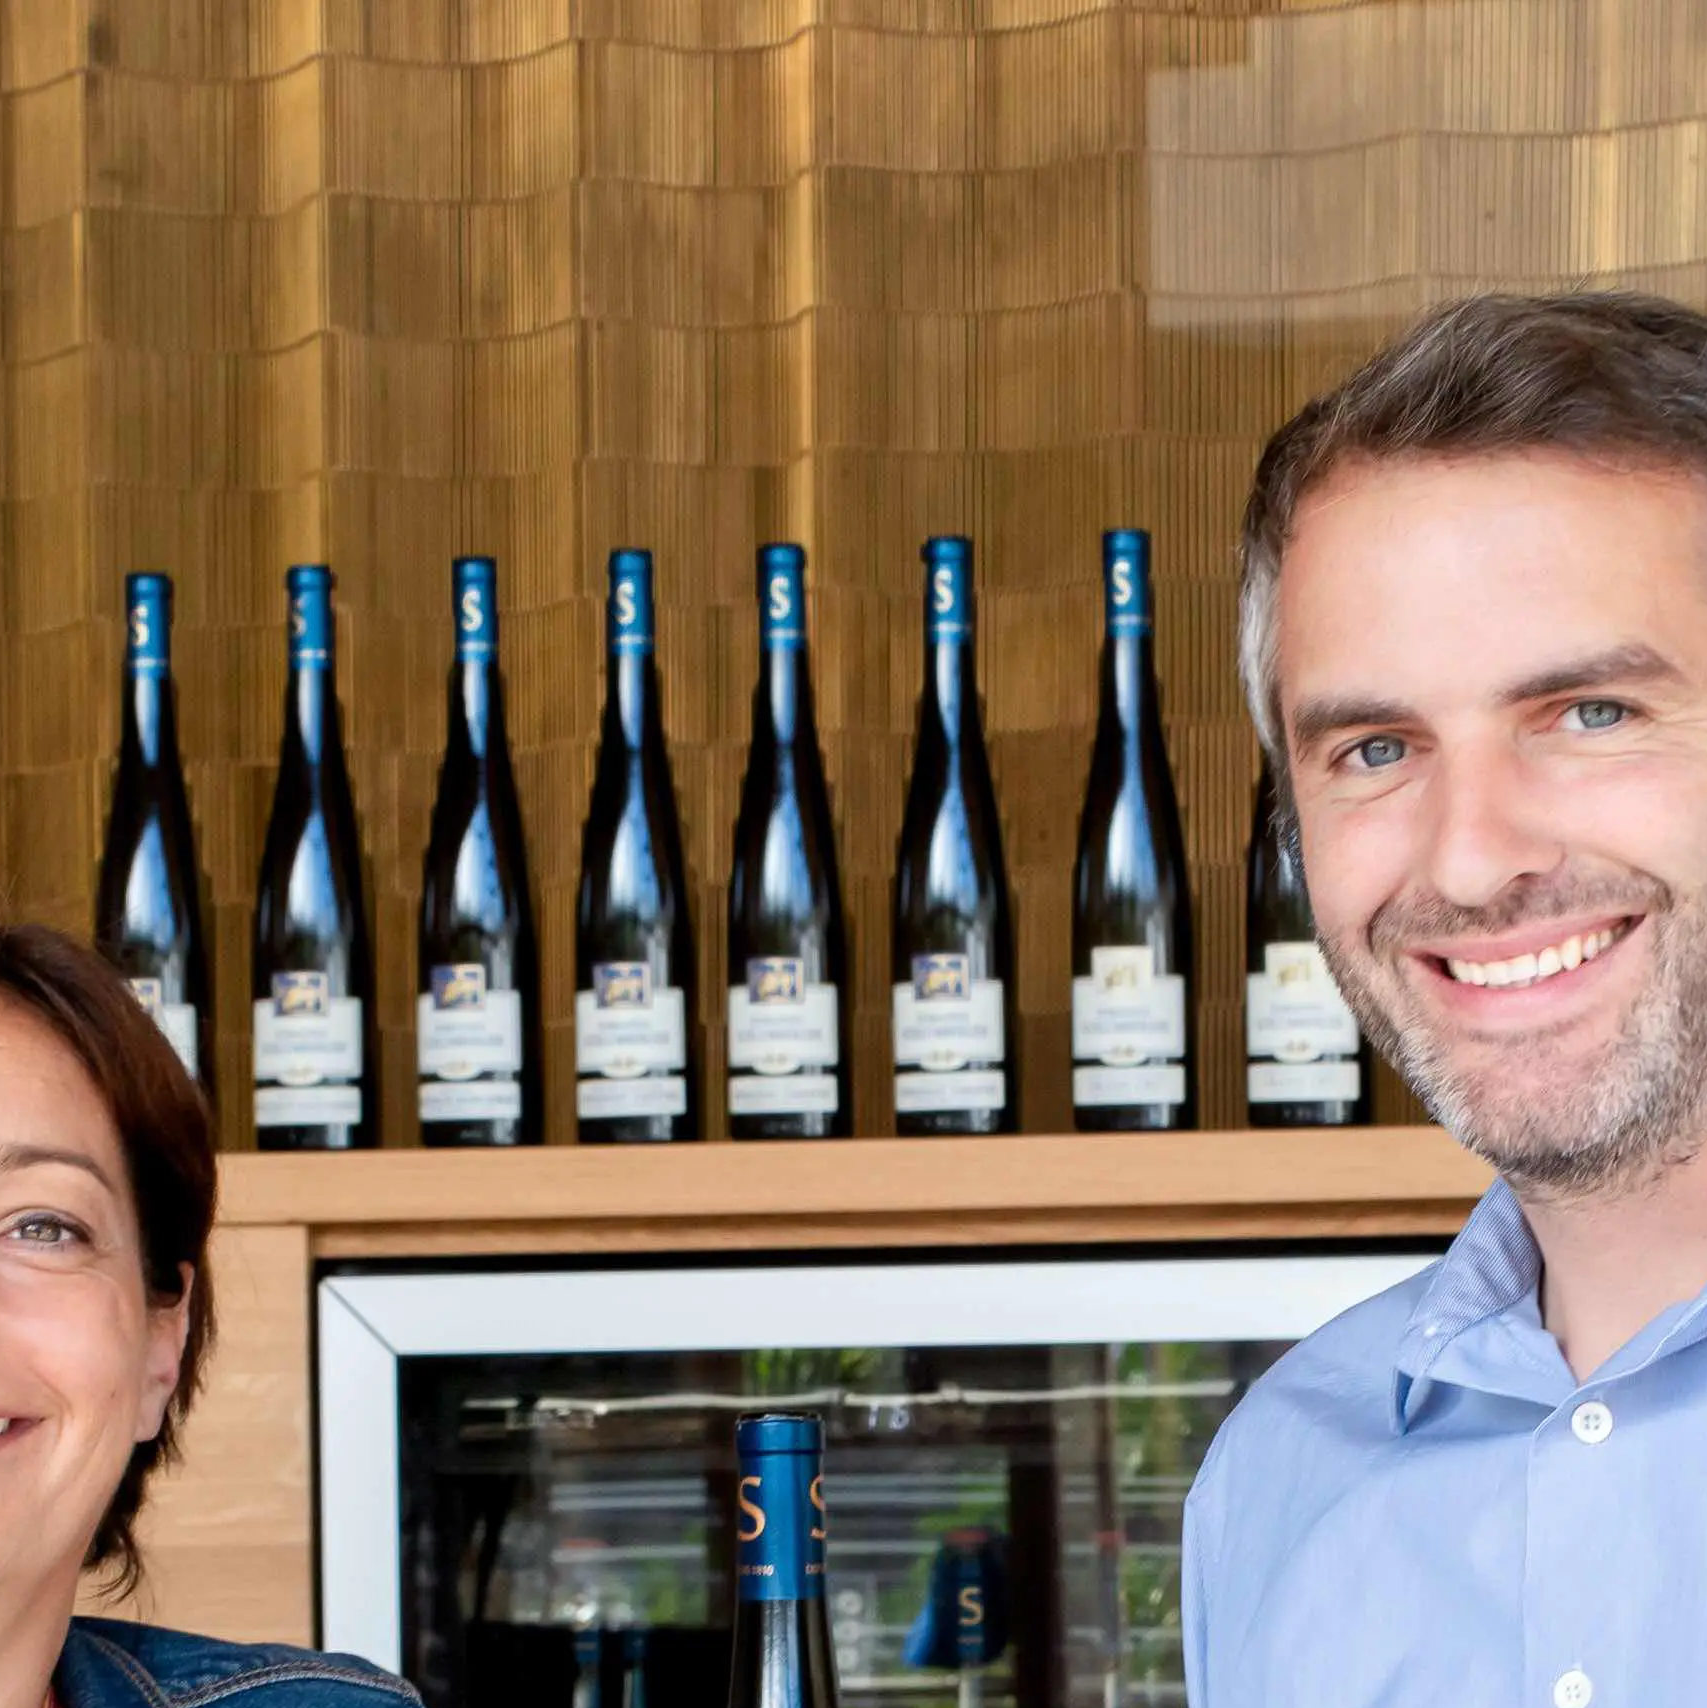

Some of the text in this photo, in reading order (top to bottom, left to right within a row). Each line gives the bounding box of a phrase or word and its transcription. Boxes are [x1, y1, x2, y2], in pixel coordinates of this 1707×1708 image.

[615, 580, 637, 626] S
[769, 575, 792, 620] S
[933, 567, 955, 613] S
[1111, 559, 1134, 606] S
[461, 587, 484, 632] S
[737, 1475, 767, 1541] S
[959, 1586, 984, 1627] S
